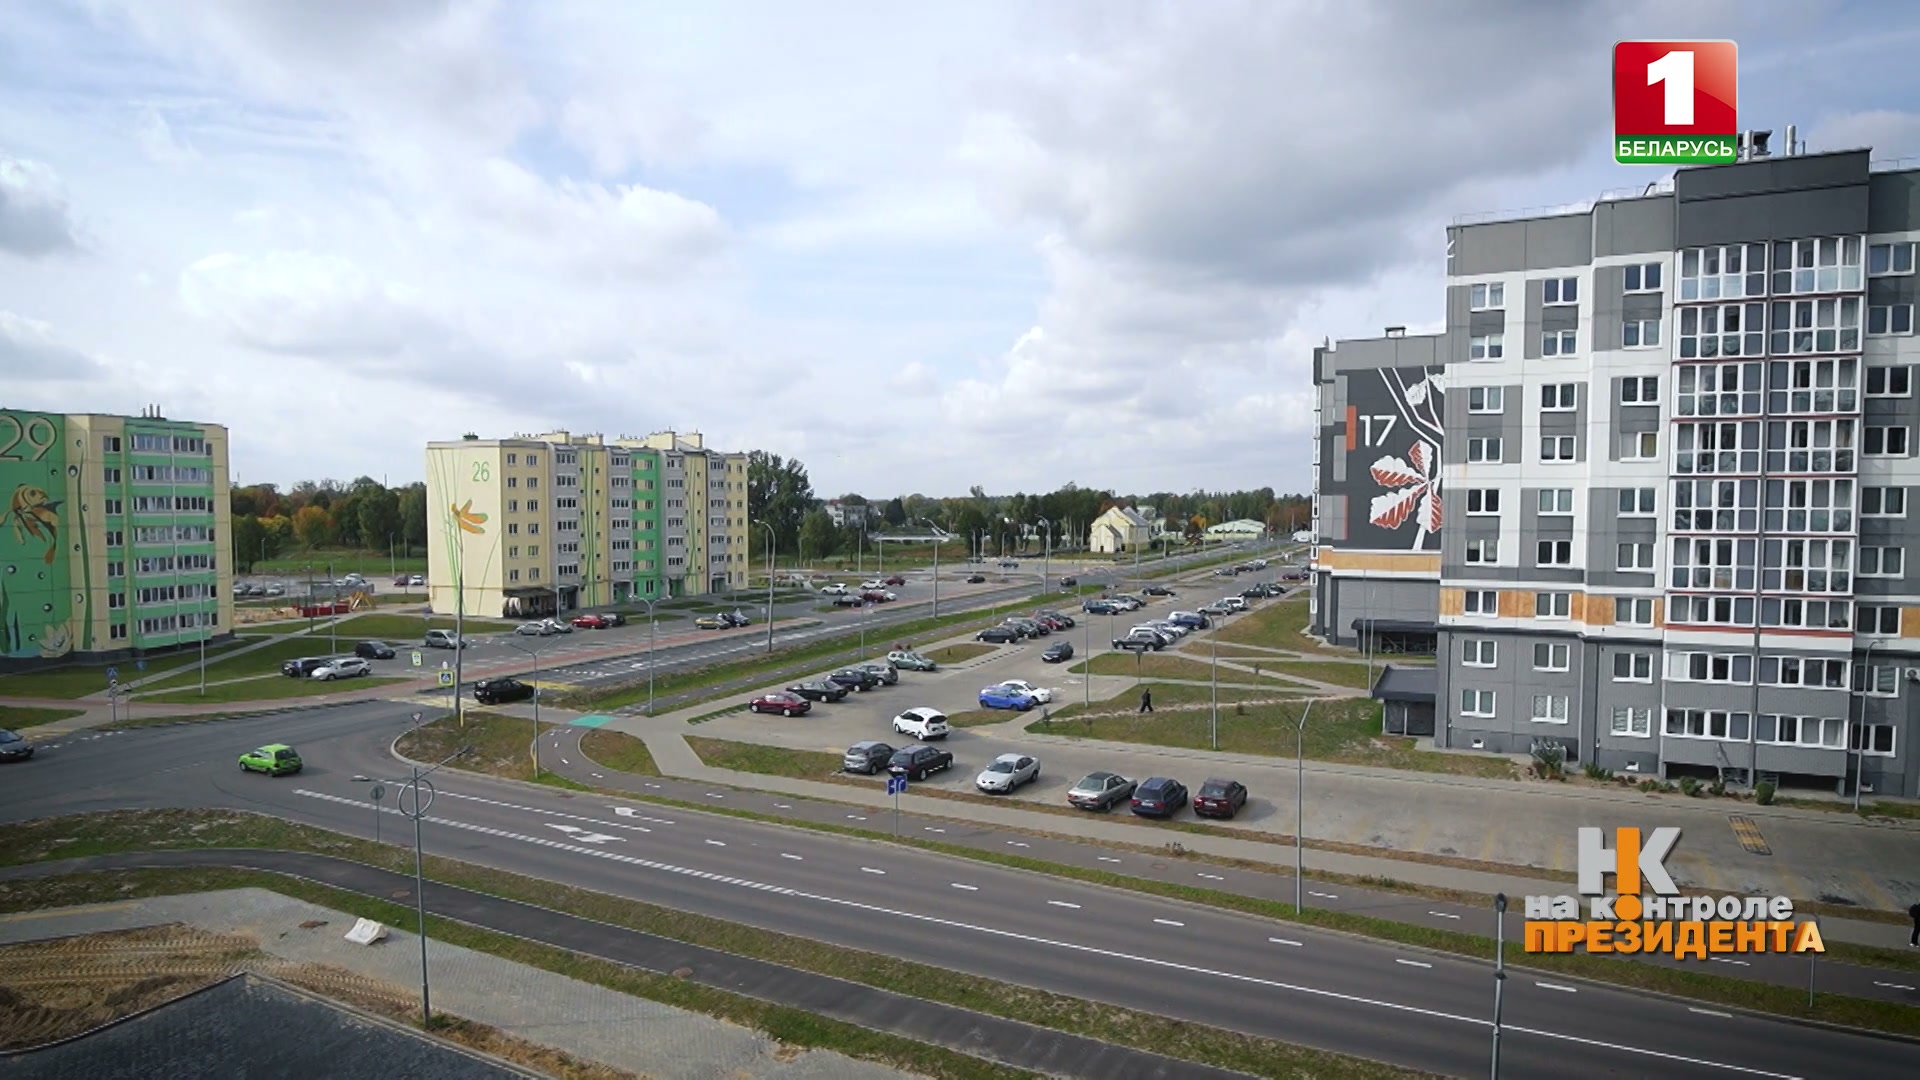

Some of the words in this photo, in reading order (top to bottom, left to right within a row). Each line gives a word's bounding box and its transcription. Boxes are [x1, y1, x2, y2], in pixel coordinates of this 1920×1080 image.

[0, 415, 57, 462] 29
[1359, 415, 1397, 447] 17
[472, 461, 490, 482] 26
